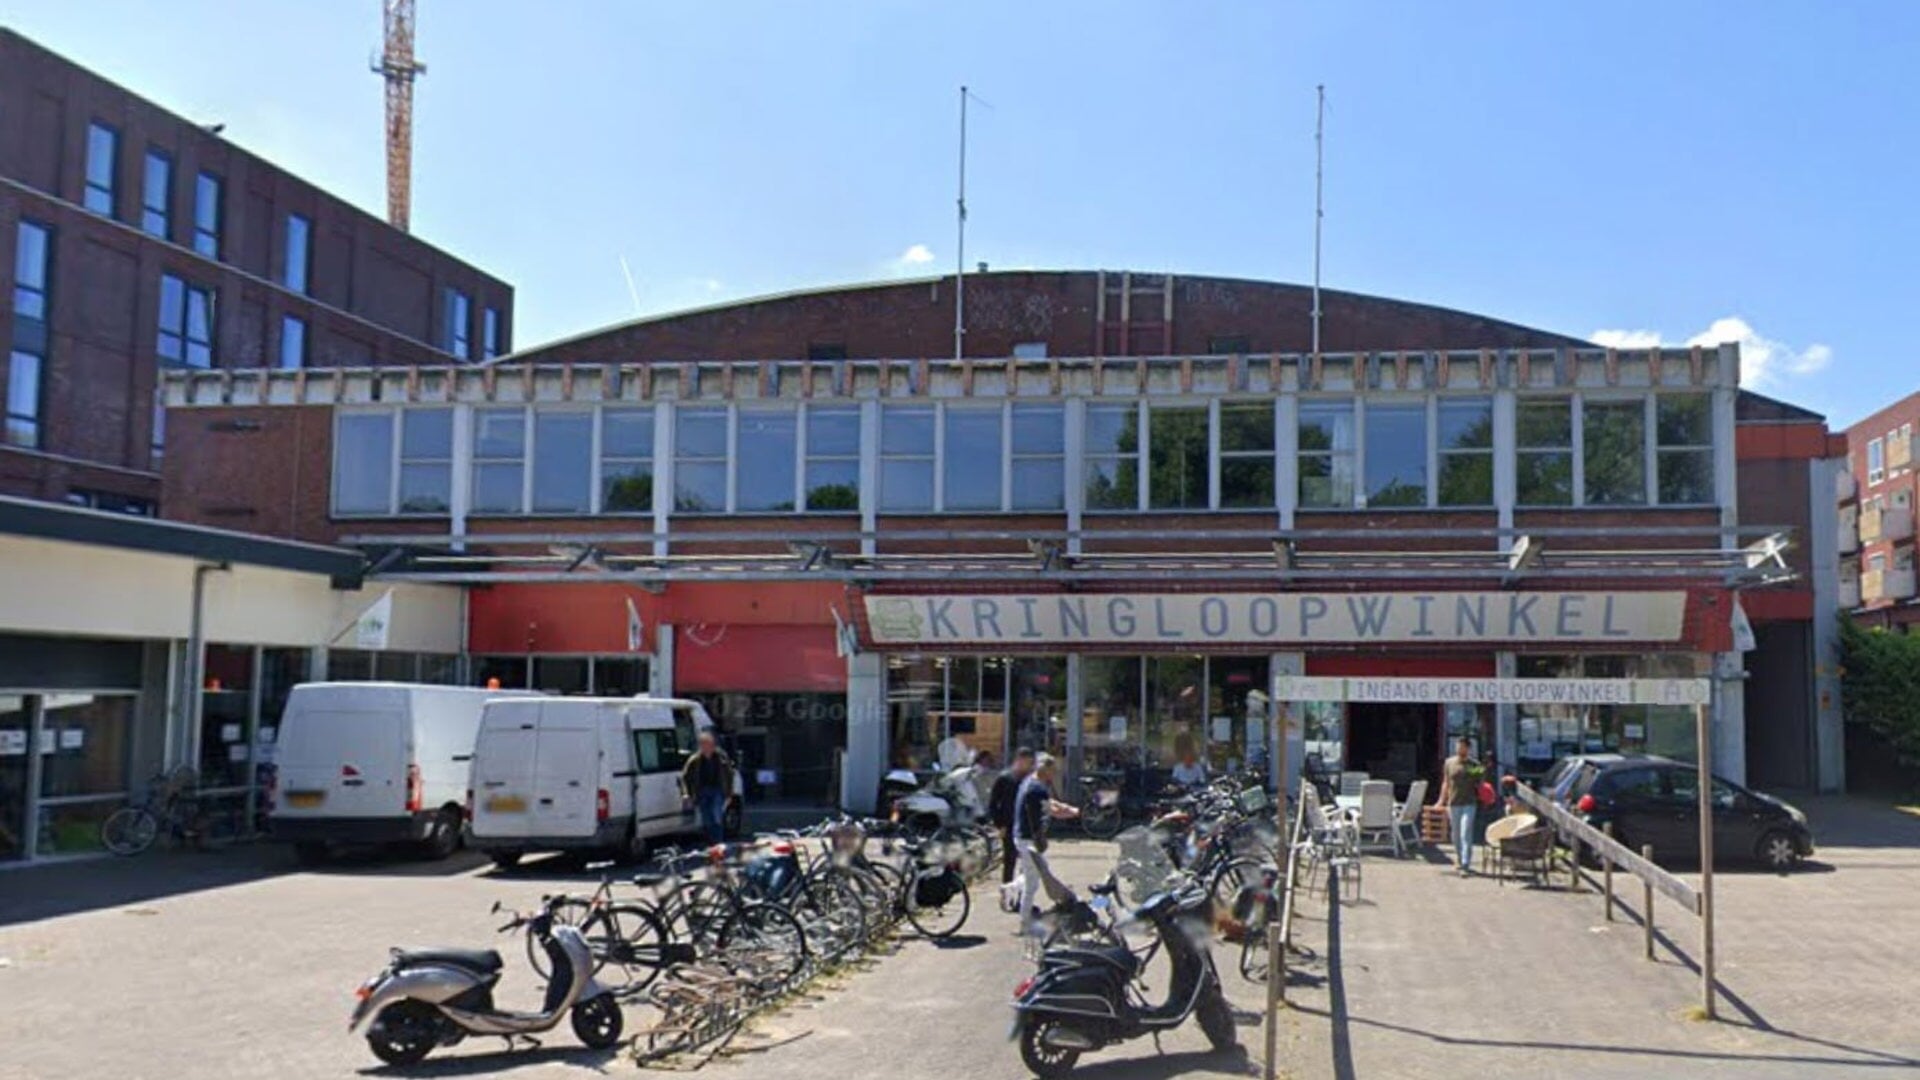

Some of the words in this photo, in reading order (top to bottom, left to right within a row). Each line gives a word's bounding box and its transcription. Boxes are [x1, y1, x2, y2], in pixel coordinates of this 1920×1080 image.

[930, 594, 1628, 638] KRINGLOOPWINKEL
[1357, 681, 1431, 700] INGANG
[1437, 682, 1627, 703] KRINGLOOPWINKEL
